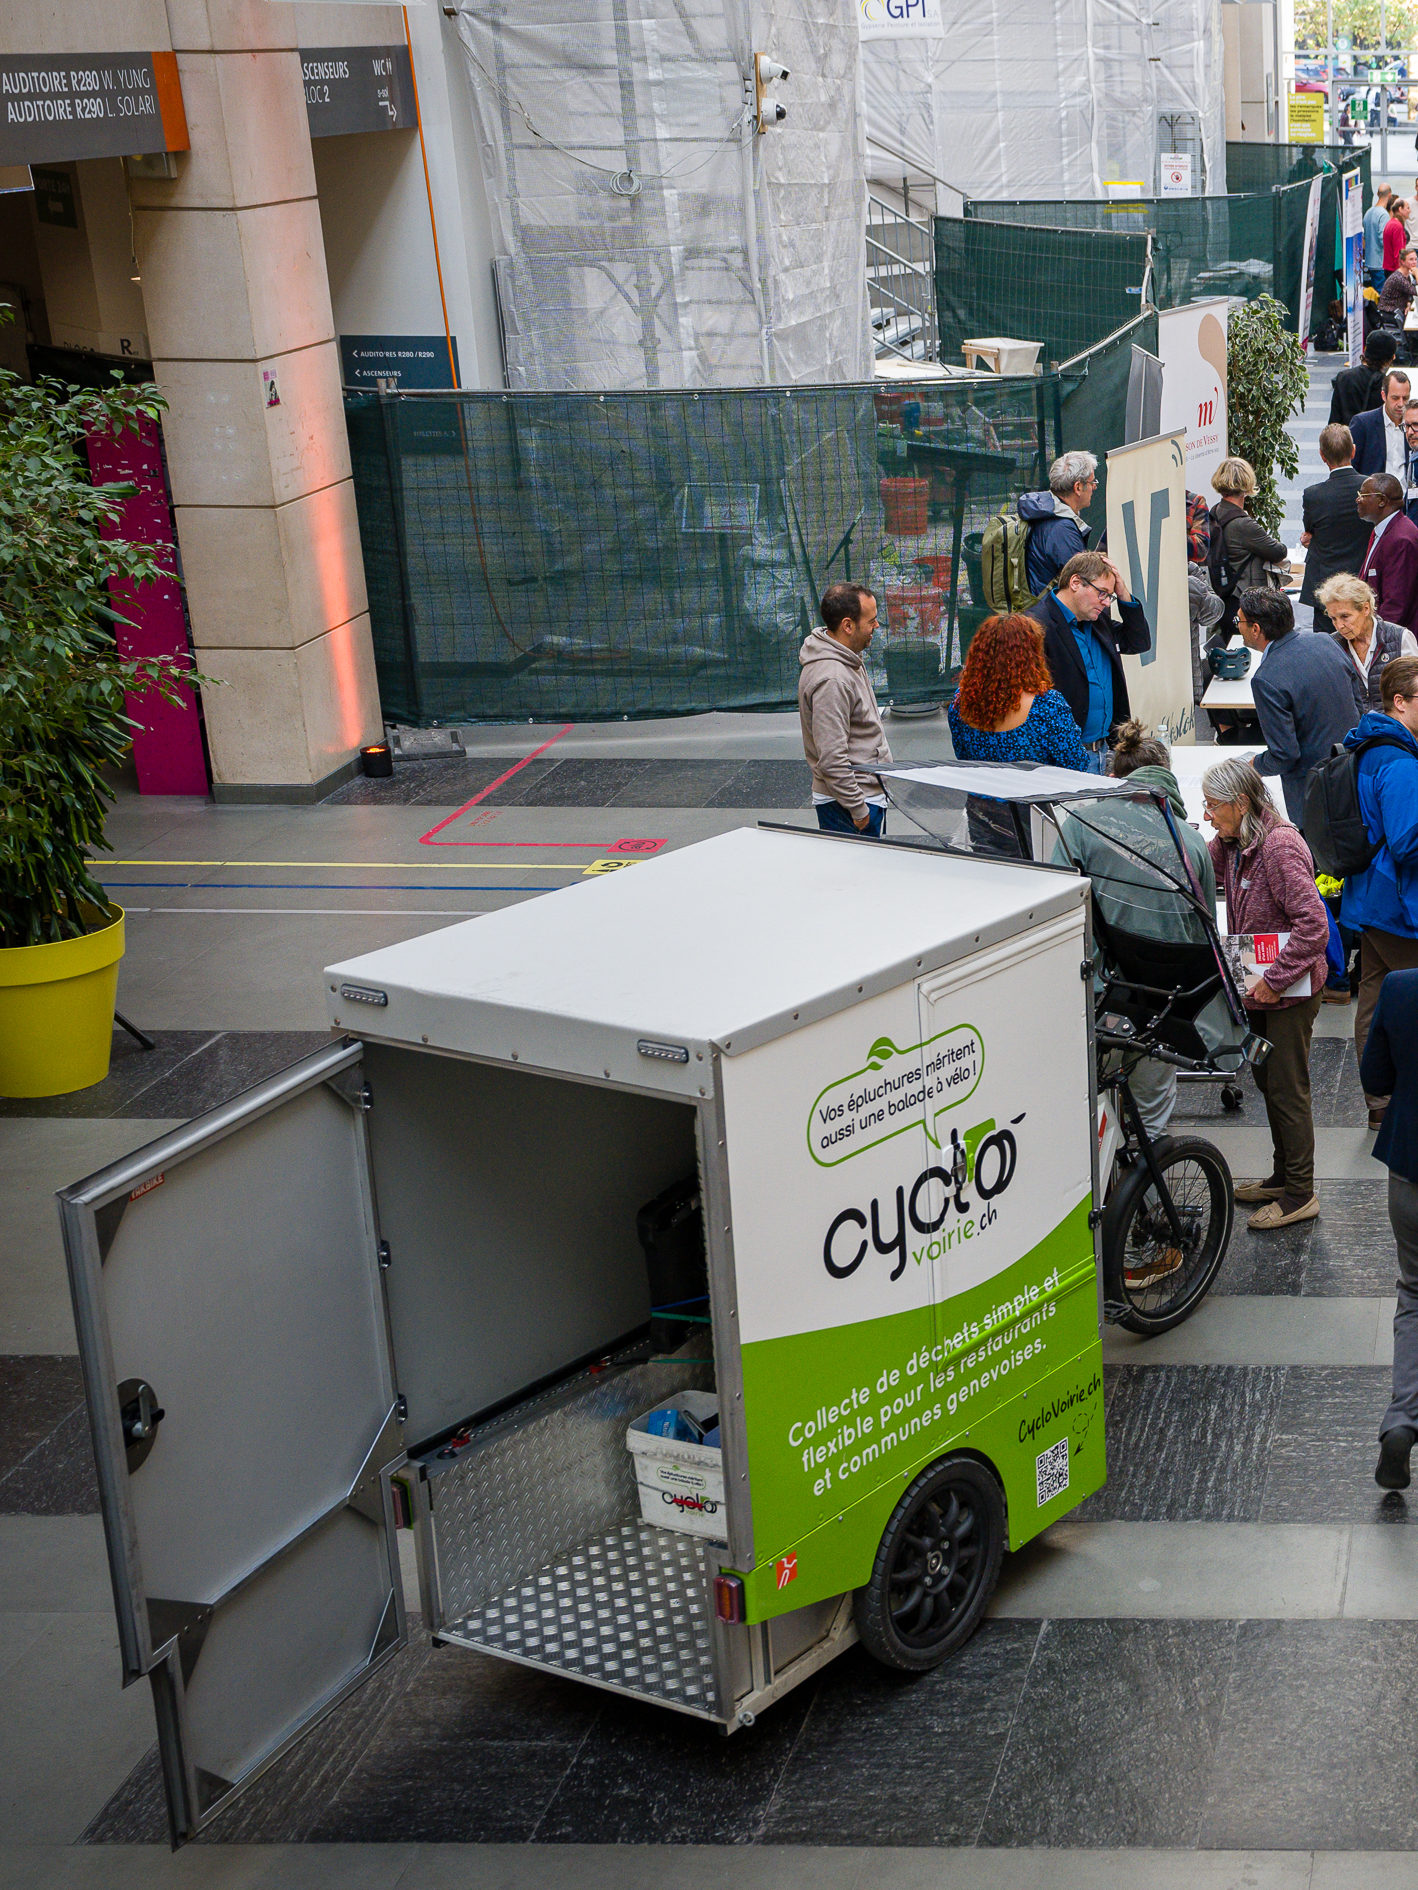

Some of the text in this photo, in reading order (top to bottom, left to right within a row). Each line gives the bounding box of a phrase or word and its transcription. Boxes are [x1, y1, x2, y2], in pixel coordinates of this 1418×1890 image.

[887, 0, 926, 19] GPI
[2, 68, 151, 94] AUDITOIRE R280 W. YUNG
[305, 85, 330, 104] LOC 2
[372, 59, 386, 76] WC
[7, 95, 156, 123] AUDITOIRE R290 L. SOLARI
[819, 1039, 976, 1124] Vos épluchures méritent
[820, 1118, 856, 1149] aussi
[859, 1111, 885, 1131] une
[888, 1085, 934, 1116] balade
[936, 1076, 944, 1094] à
[945, 1065, 971, 1089] vélo
[912, 1202, 998, 1266] voirie.ch
[788, 1267, 1060, 1447] Collecte de déchets simple et
[802, 1300, 1057, 1473] flexible pour les restaurants
[813, 1337, 1047, 1496] et communes genevoises.
[1018, 1374, 1101, 1443] CycloVoirie.ch
